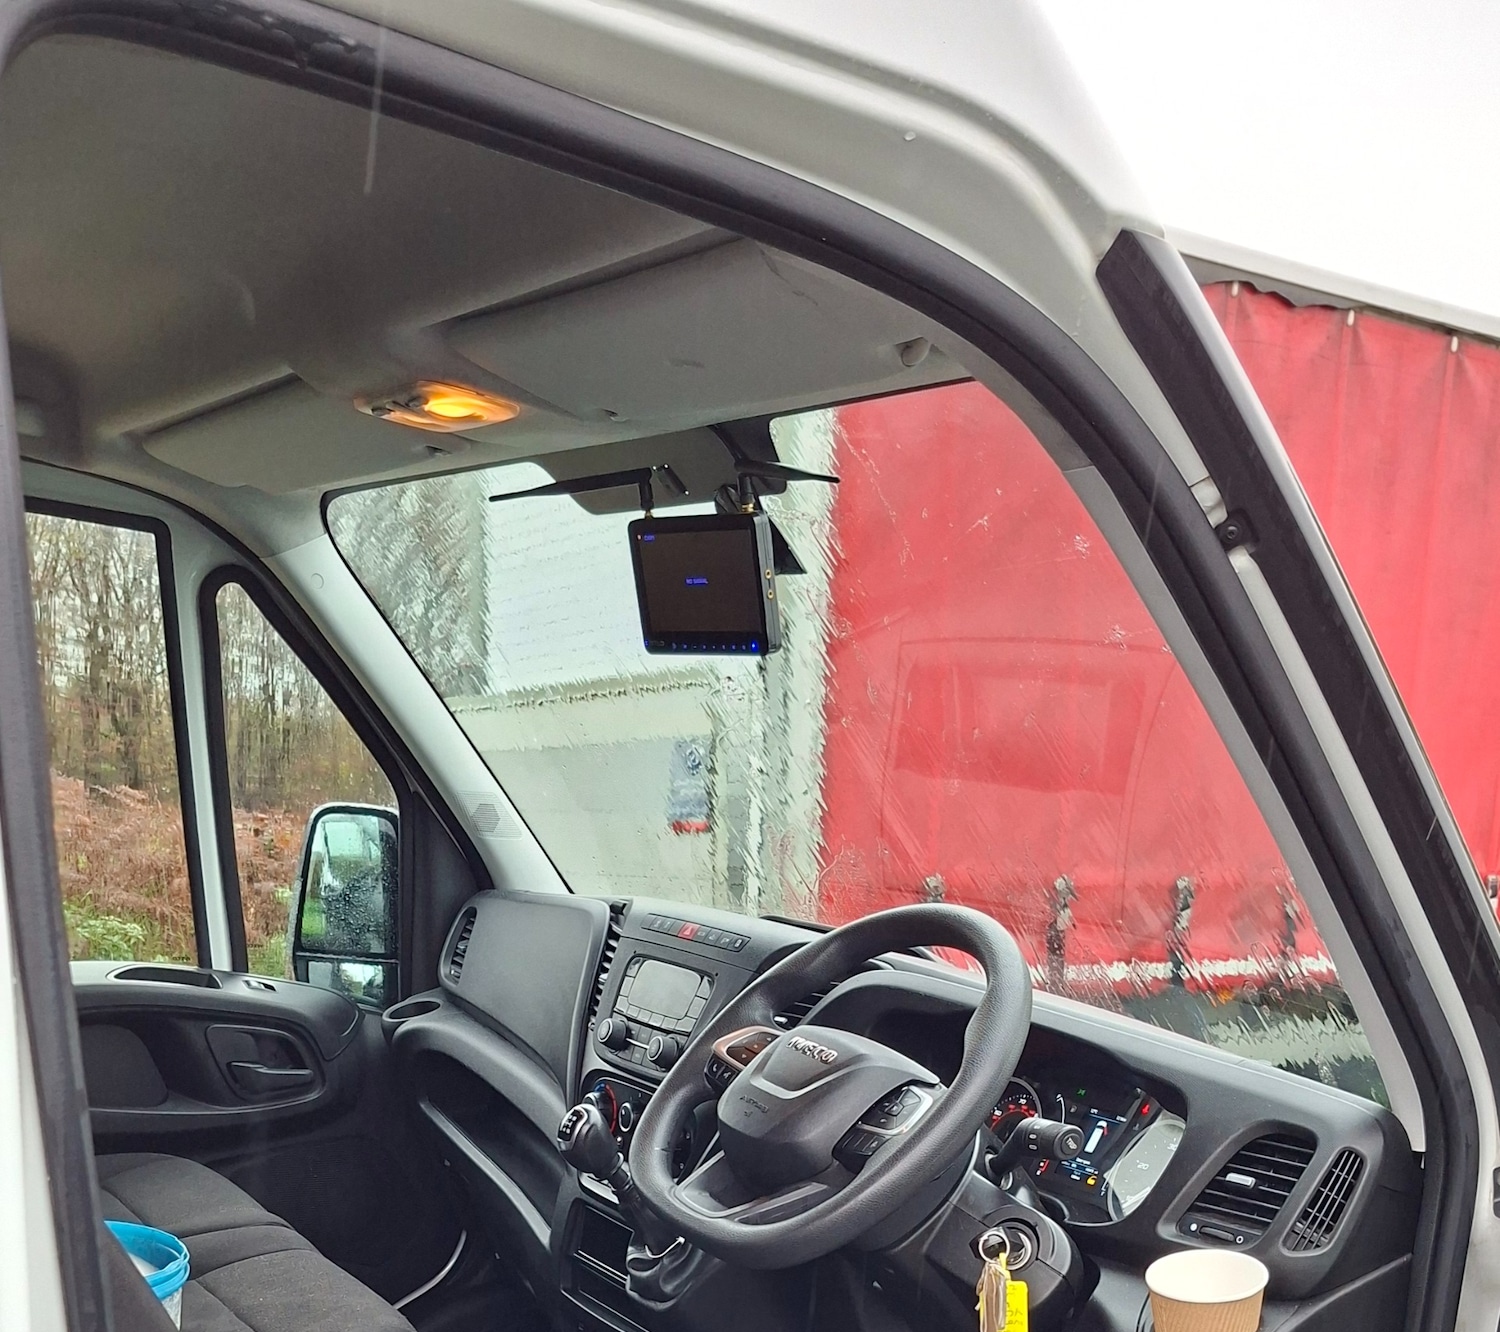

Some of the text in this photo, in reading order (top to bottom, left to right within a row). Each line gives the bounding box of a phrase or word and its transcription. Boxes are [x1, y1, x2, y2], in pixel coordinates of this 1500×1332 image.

[785, 1036, 838, 1064] IVECO
[1066, 1137, 1078, 1150] TRIP
[1136, 1162, 1150, 1170] 20
